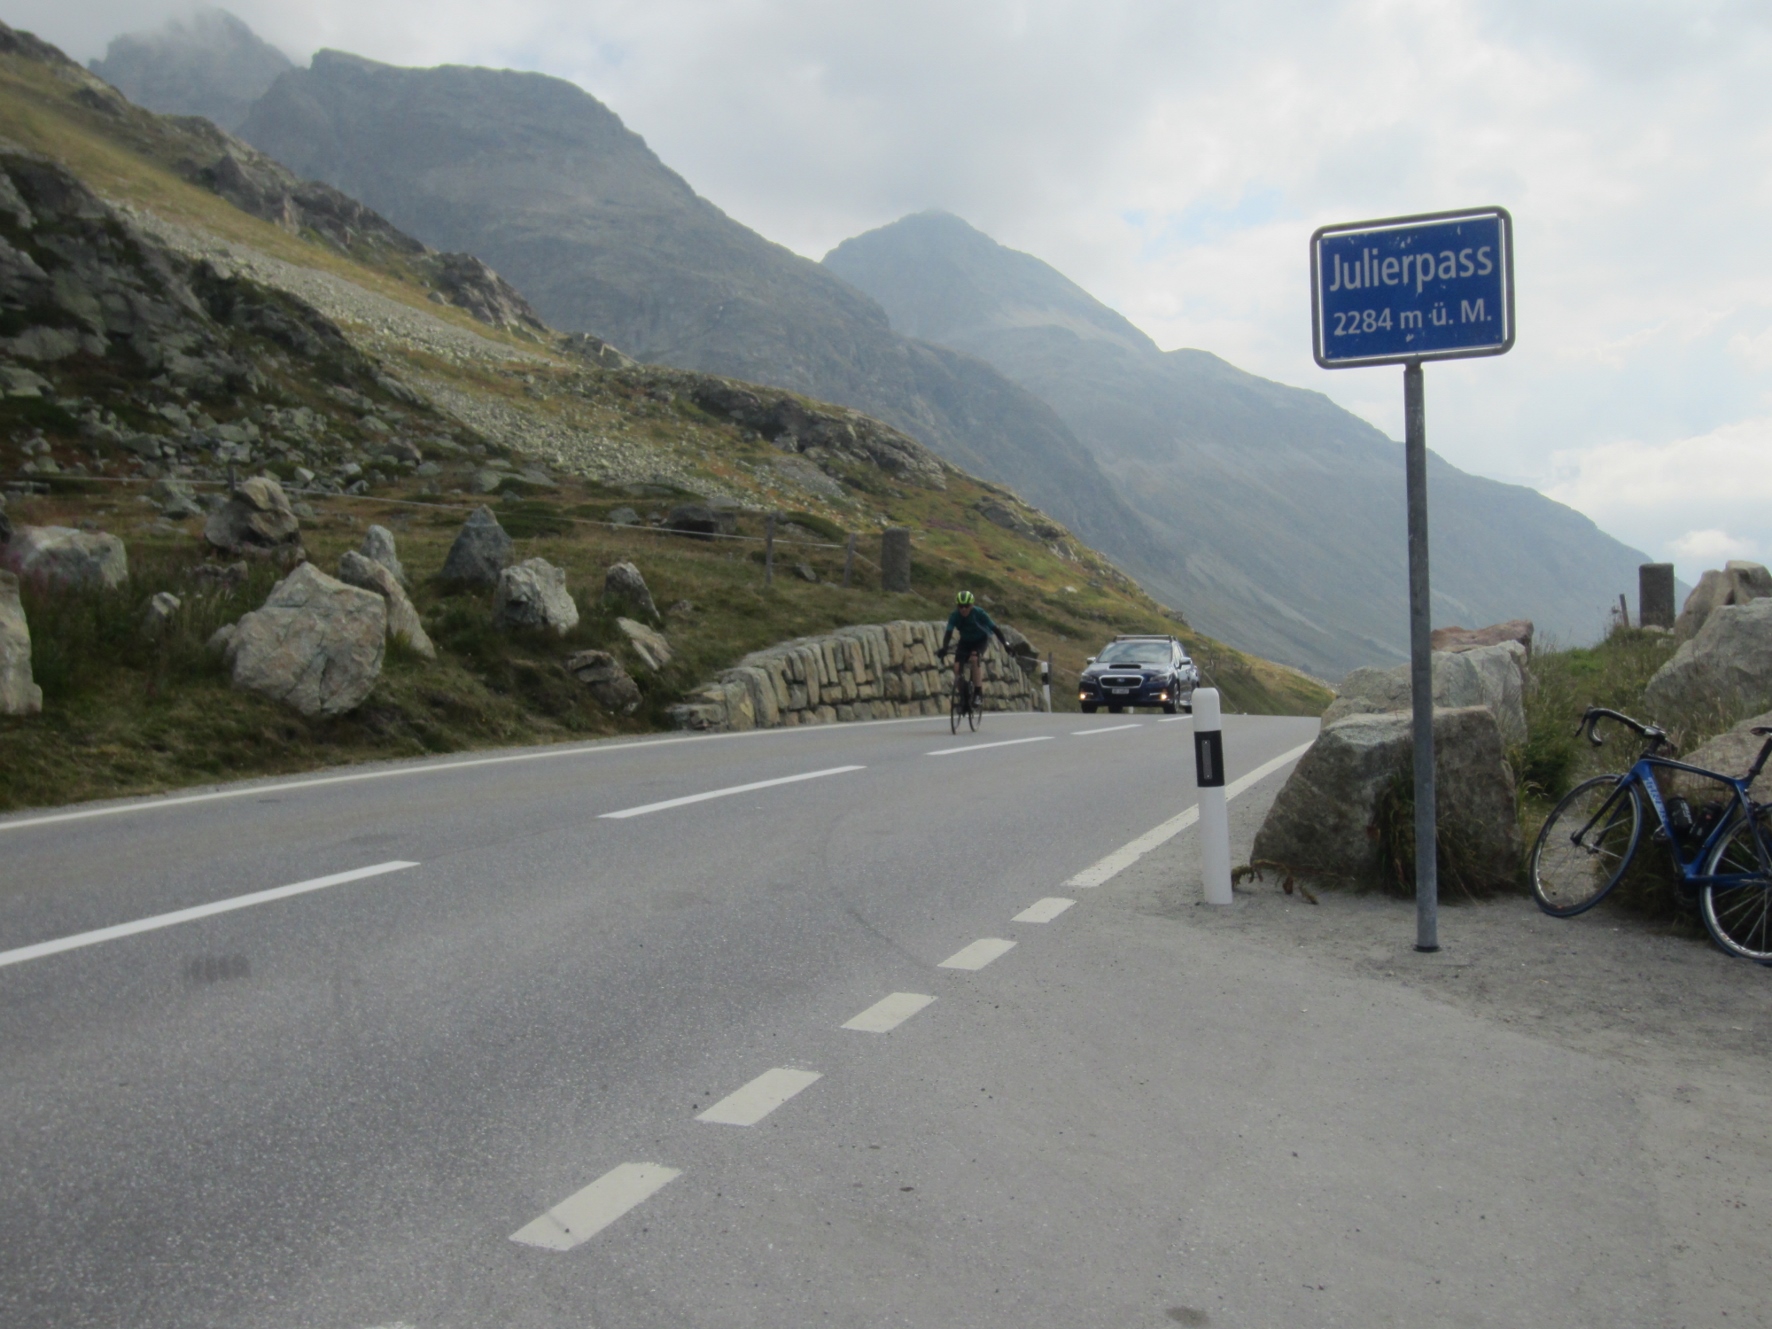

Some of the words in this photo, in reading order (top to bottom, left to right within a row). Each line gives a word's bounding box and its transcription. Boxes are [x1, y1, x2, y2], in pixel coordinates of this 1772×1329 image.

[1329, 245, 1493, 293] Julierpass
[1334, 307, 1393, 336] 2284
[1400, 310, 1422, 329] m
[1432, 302, 1453, 326] ü.
[1461, 298, 1492, 323] M.
